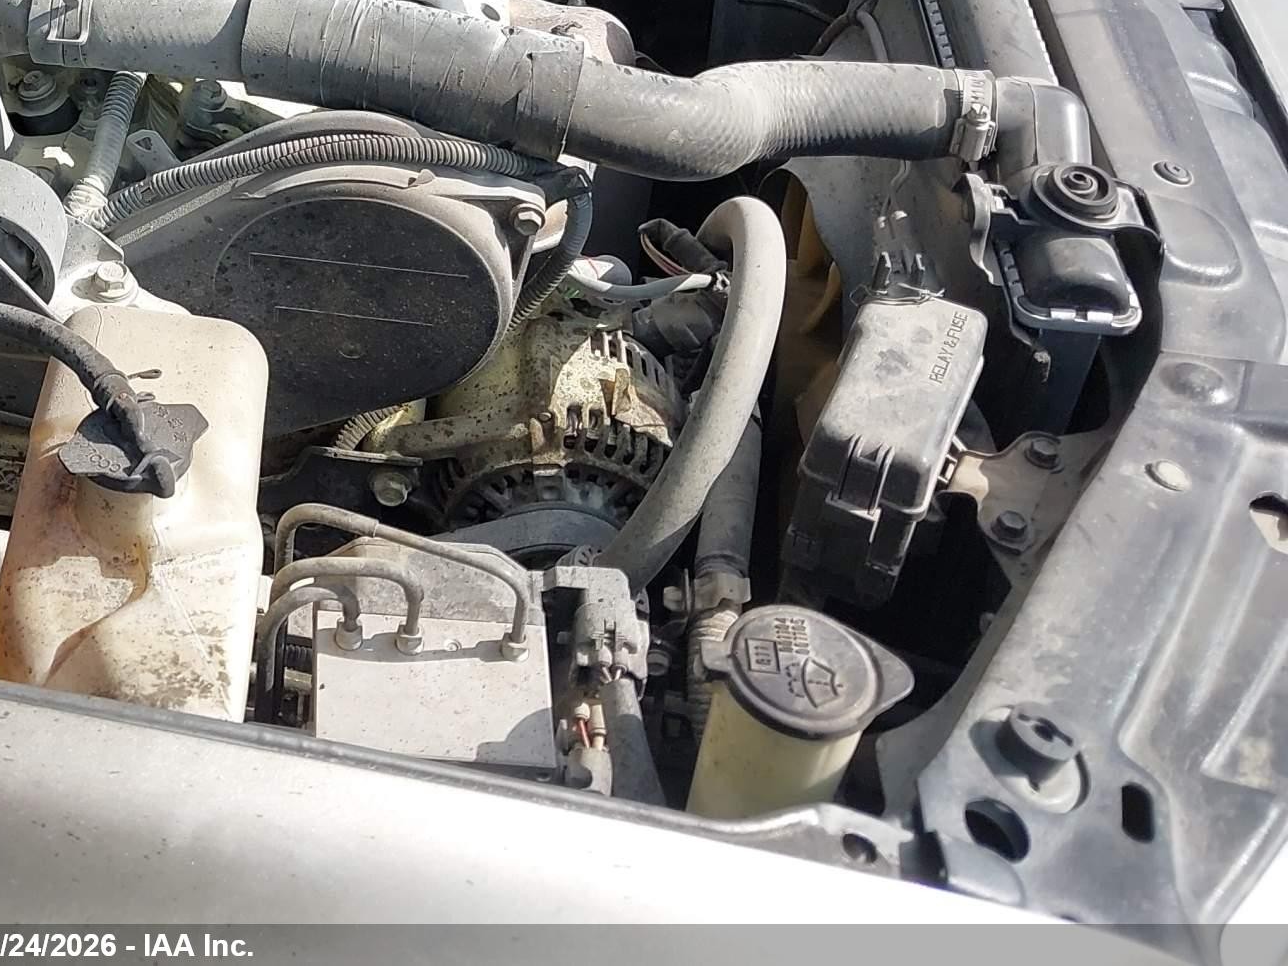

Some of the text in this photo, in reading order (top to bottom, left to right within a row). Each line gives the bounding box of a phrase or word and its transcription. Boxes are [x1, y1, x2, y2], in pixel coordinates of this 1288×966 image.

[929, 311, 968, 384] RELAY & FUSE
